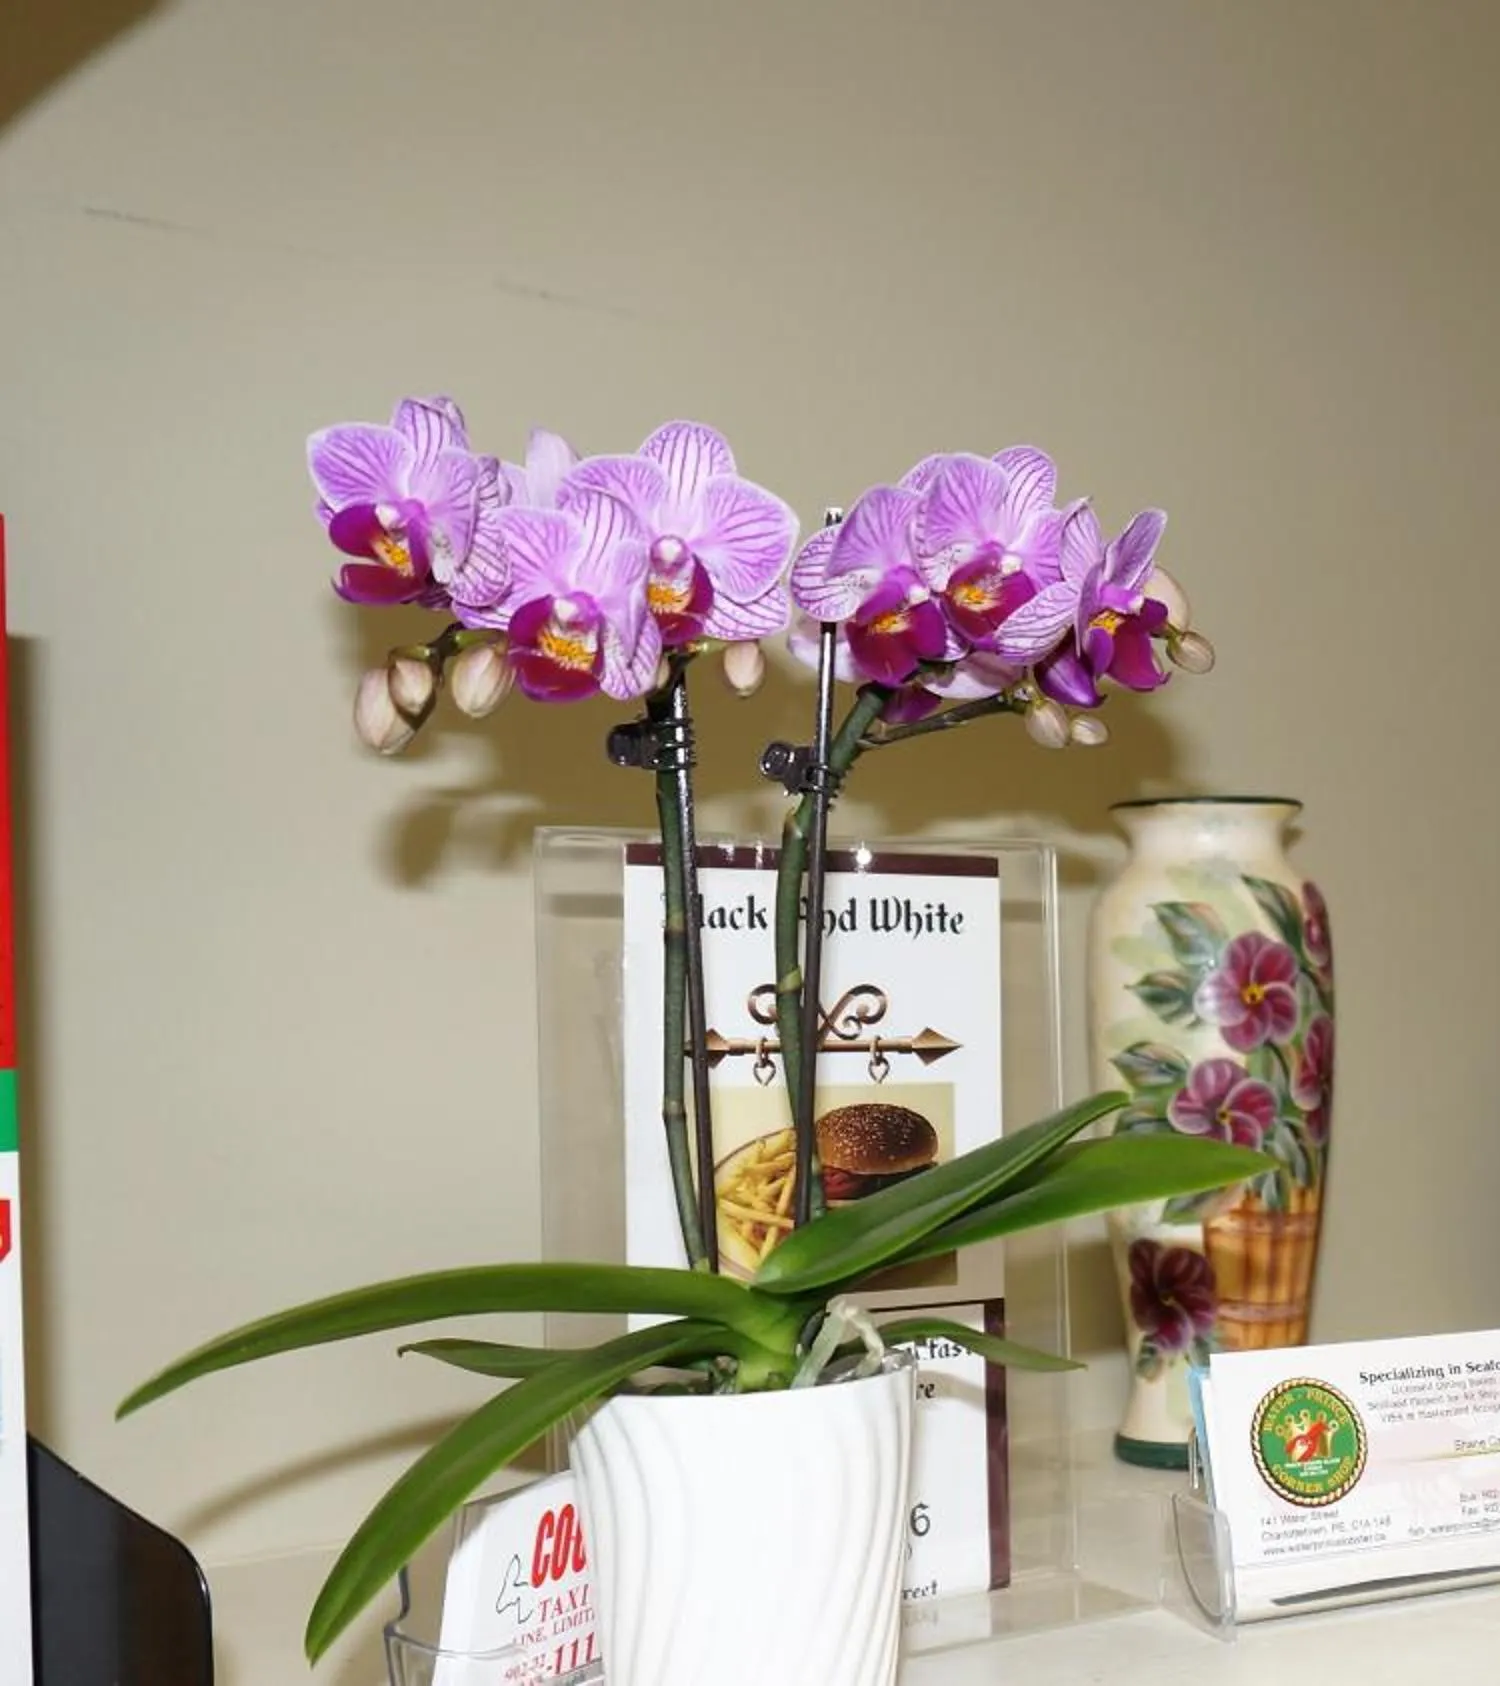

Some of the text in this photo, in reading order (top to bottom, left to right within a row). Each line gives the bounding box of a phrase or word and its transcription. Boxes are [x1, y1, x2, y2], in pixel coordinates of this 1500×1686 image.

[661, 893, 768, 930] lack
[869, 896, 964, 939] White
[1359, 1366, 1444, 1385] Specializing
[1449, 1363, 1461, 1376] in
[539, 1584, 589, 1623] TAXI
